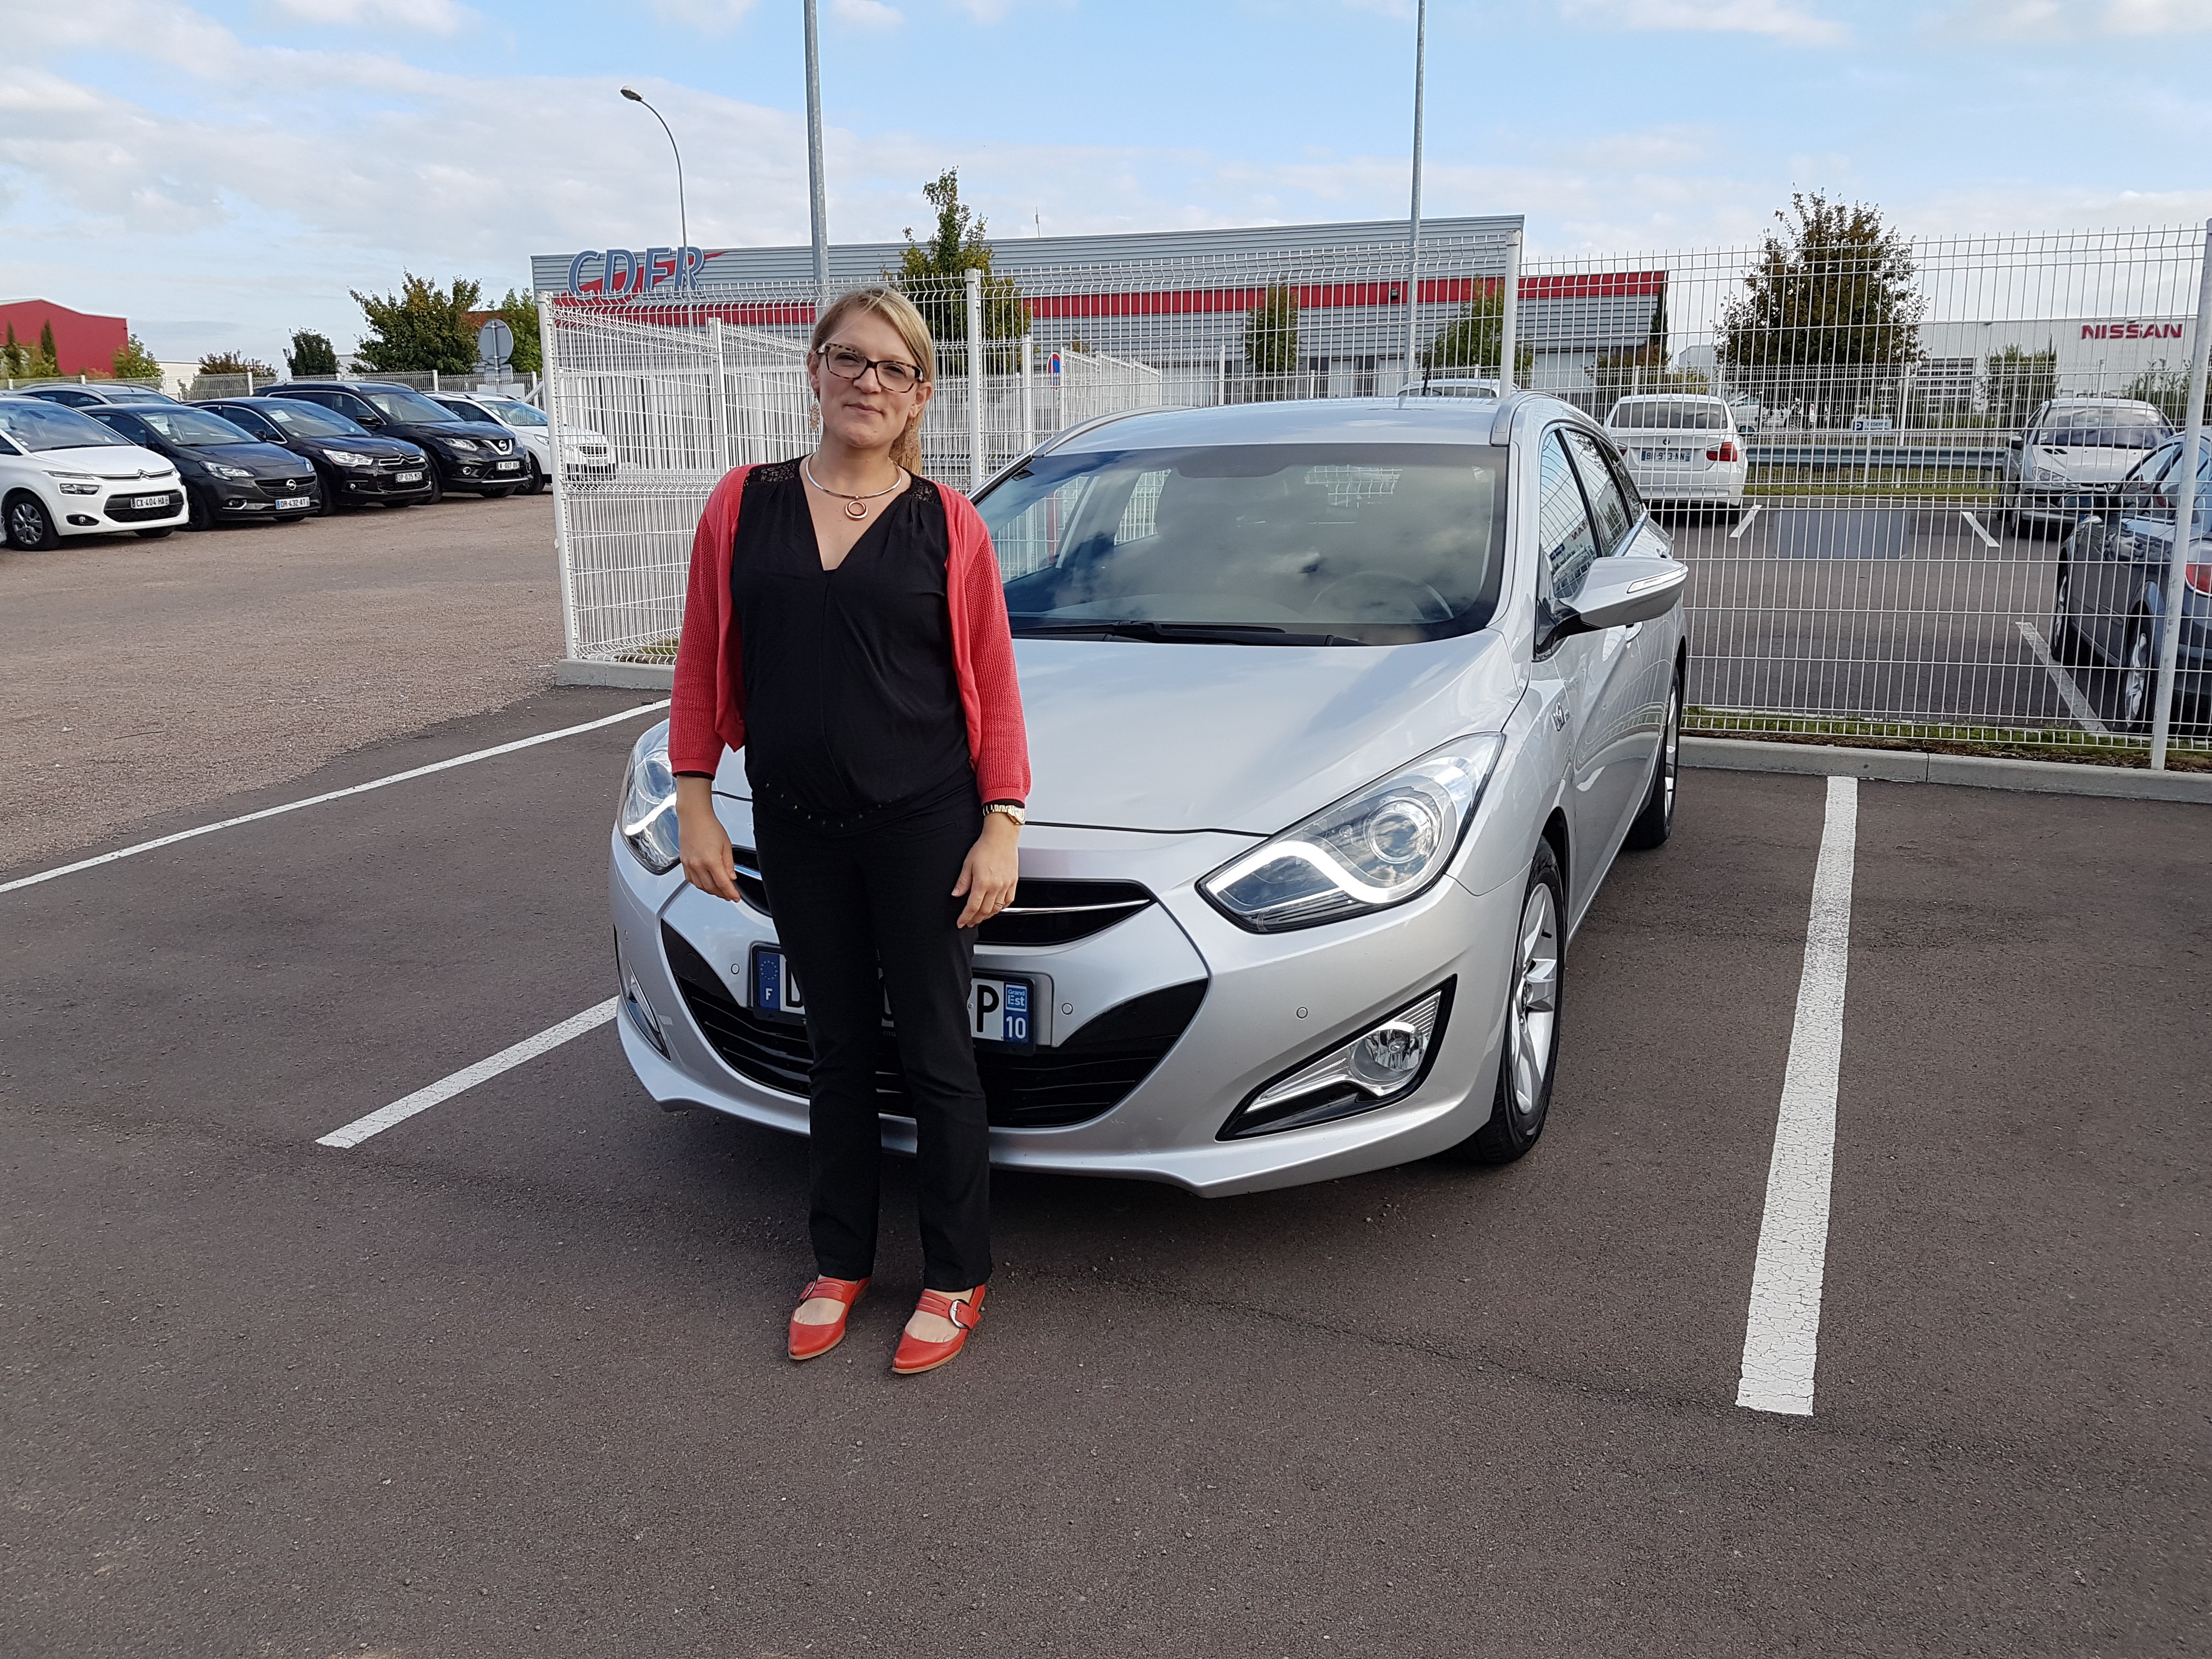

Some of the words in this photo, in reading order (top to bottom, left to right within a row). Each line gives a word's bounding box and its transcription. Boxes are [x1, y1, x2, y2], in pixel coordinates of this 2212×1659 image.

[567, 247, 705, 300] CDER
[2081, 324, 2183, 339] NISSAN
[136, 496, 165, 507] CX-404-HA
[765, 988, 773, 1000] F
[1008, 995, 1025, 1006] Est
[1006, 1015, 1026, 1039] 10
